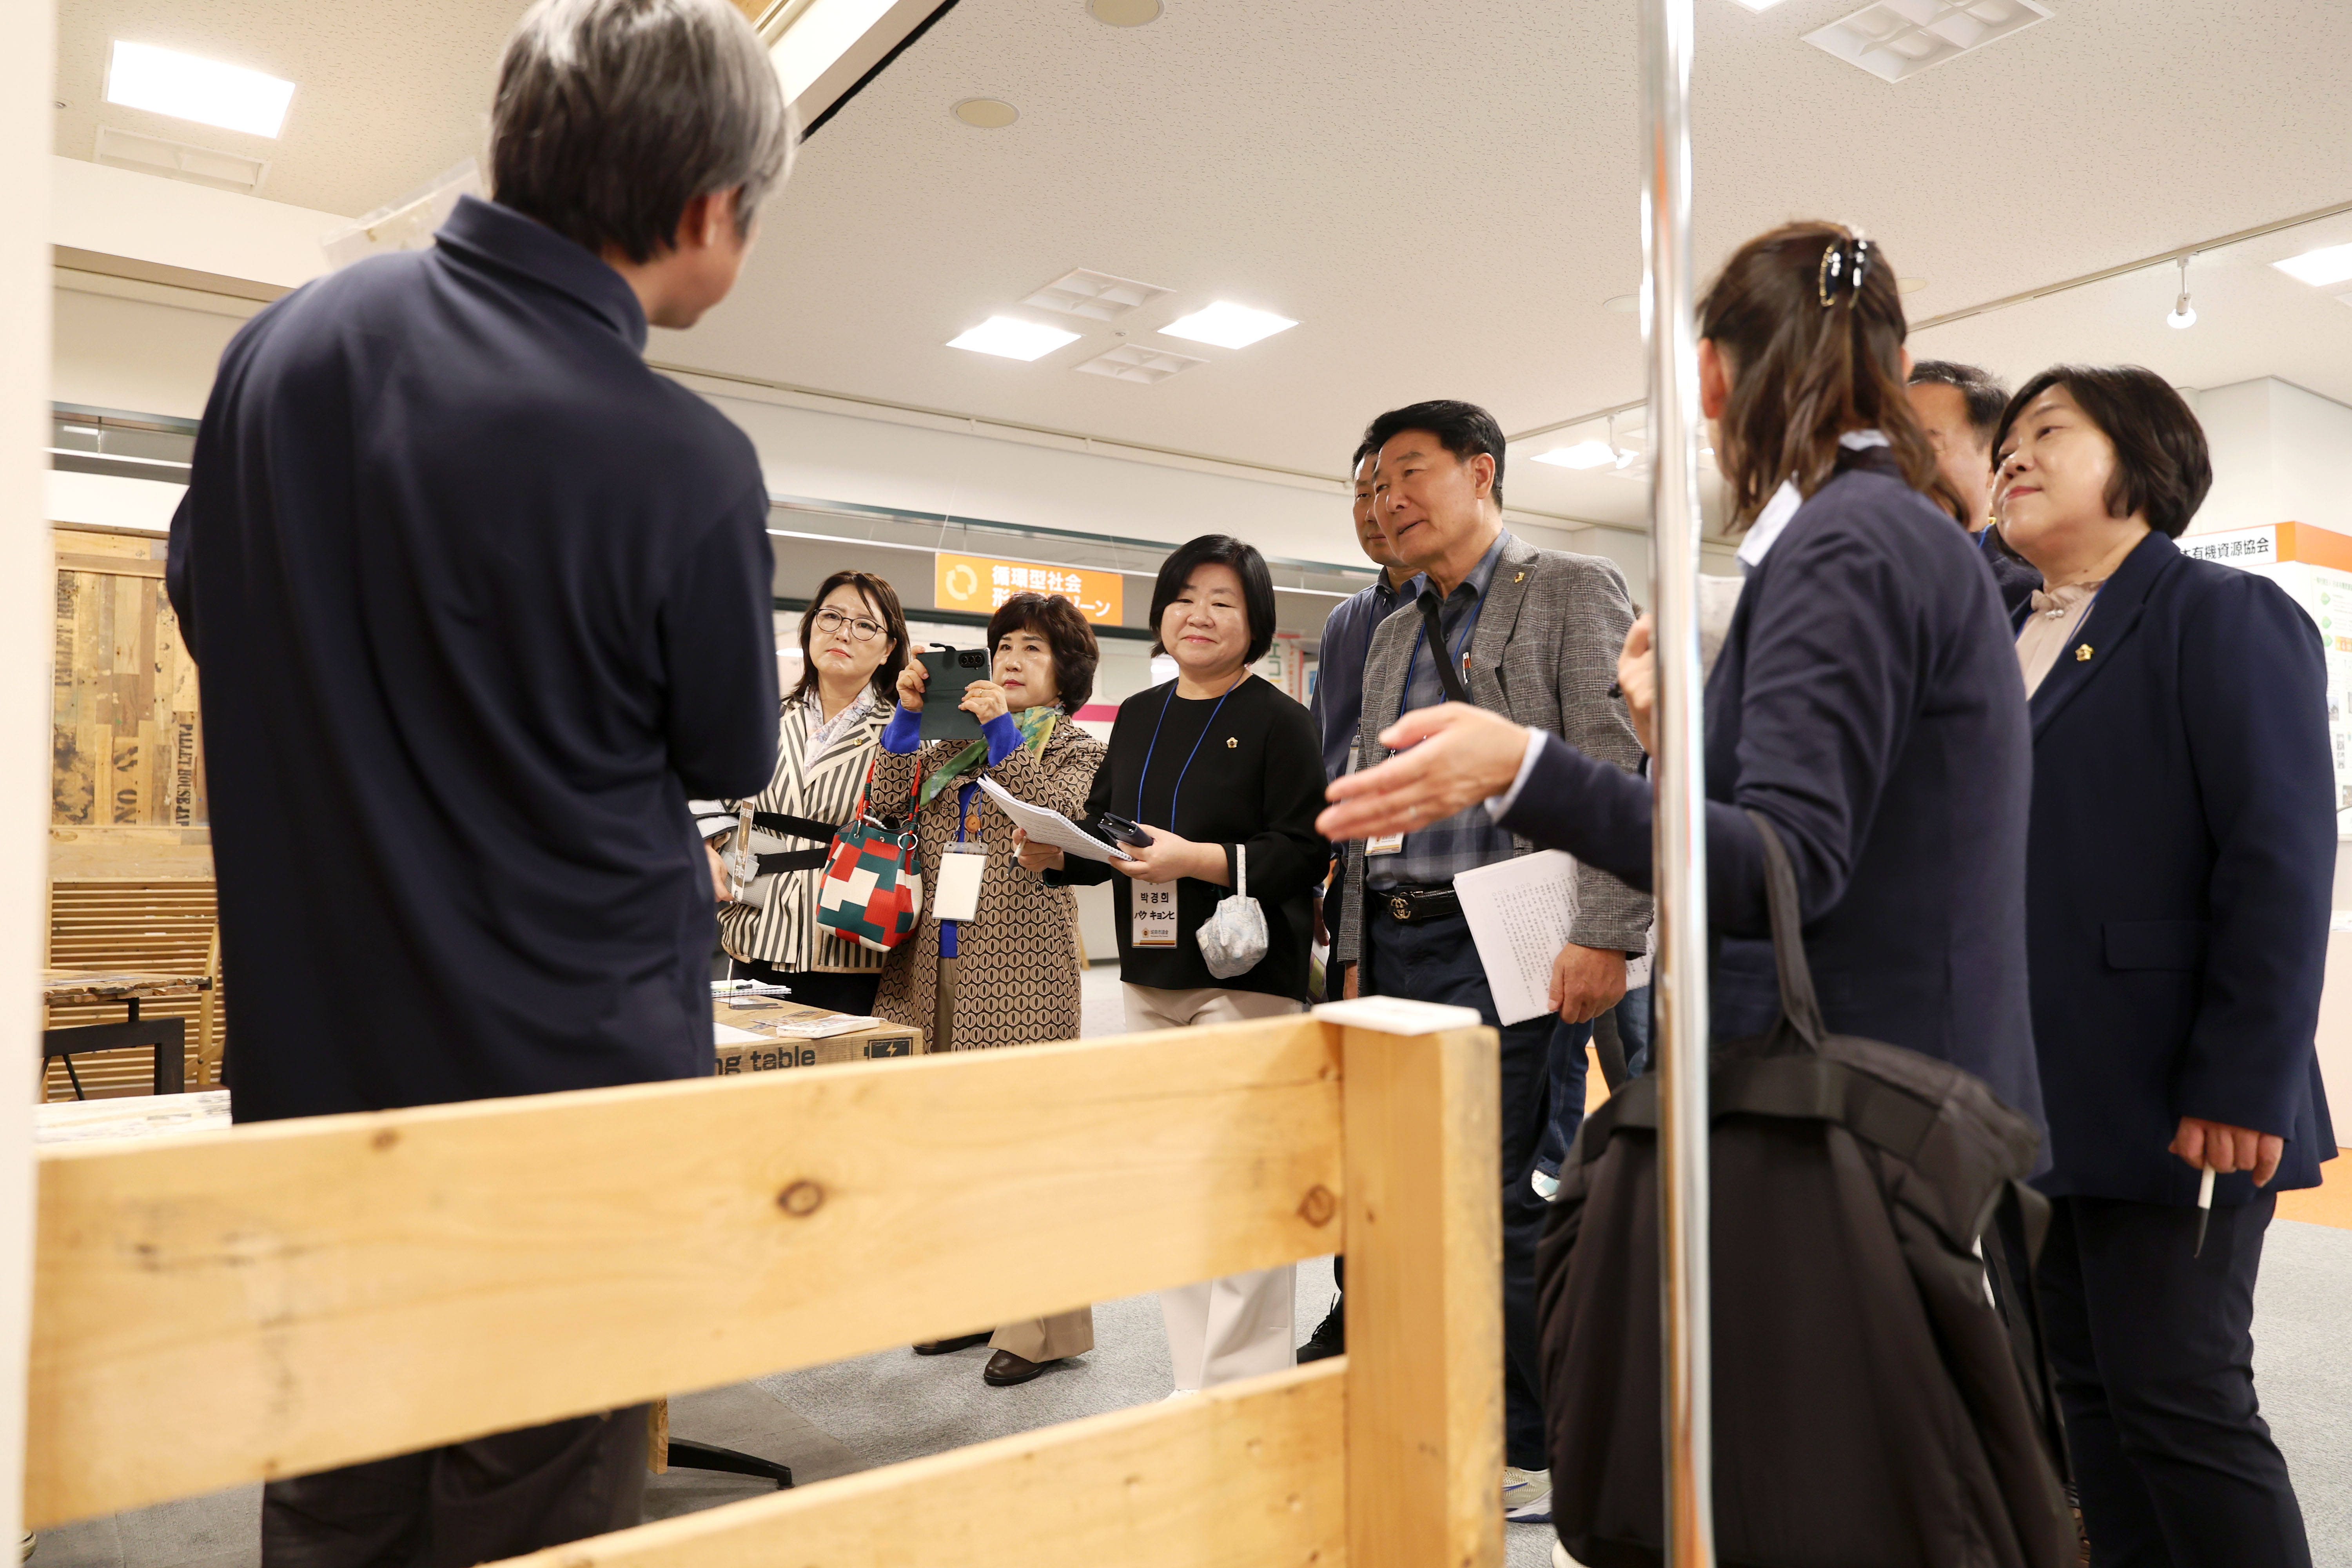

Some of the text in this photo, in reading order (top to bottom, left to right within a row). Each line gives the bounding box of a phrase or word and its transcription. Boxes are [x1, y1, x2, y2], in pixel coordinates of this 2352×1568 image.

[992, 565, 1082, 593] 循環型社会
[177, 724, 193, 766] PALLET
[176, 769, 192, 804] HOUSE
[1141, 892, 1169, 904] 박경희
[1134, 910, 1175, 920] パク キョンヒ
[750, 1046, 815, 1071] table
